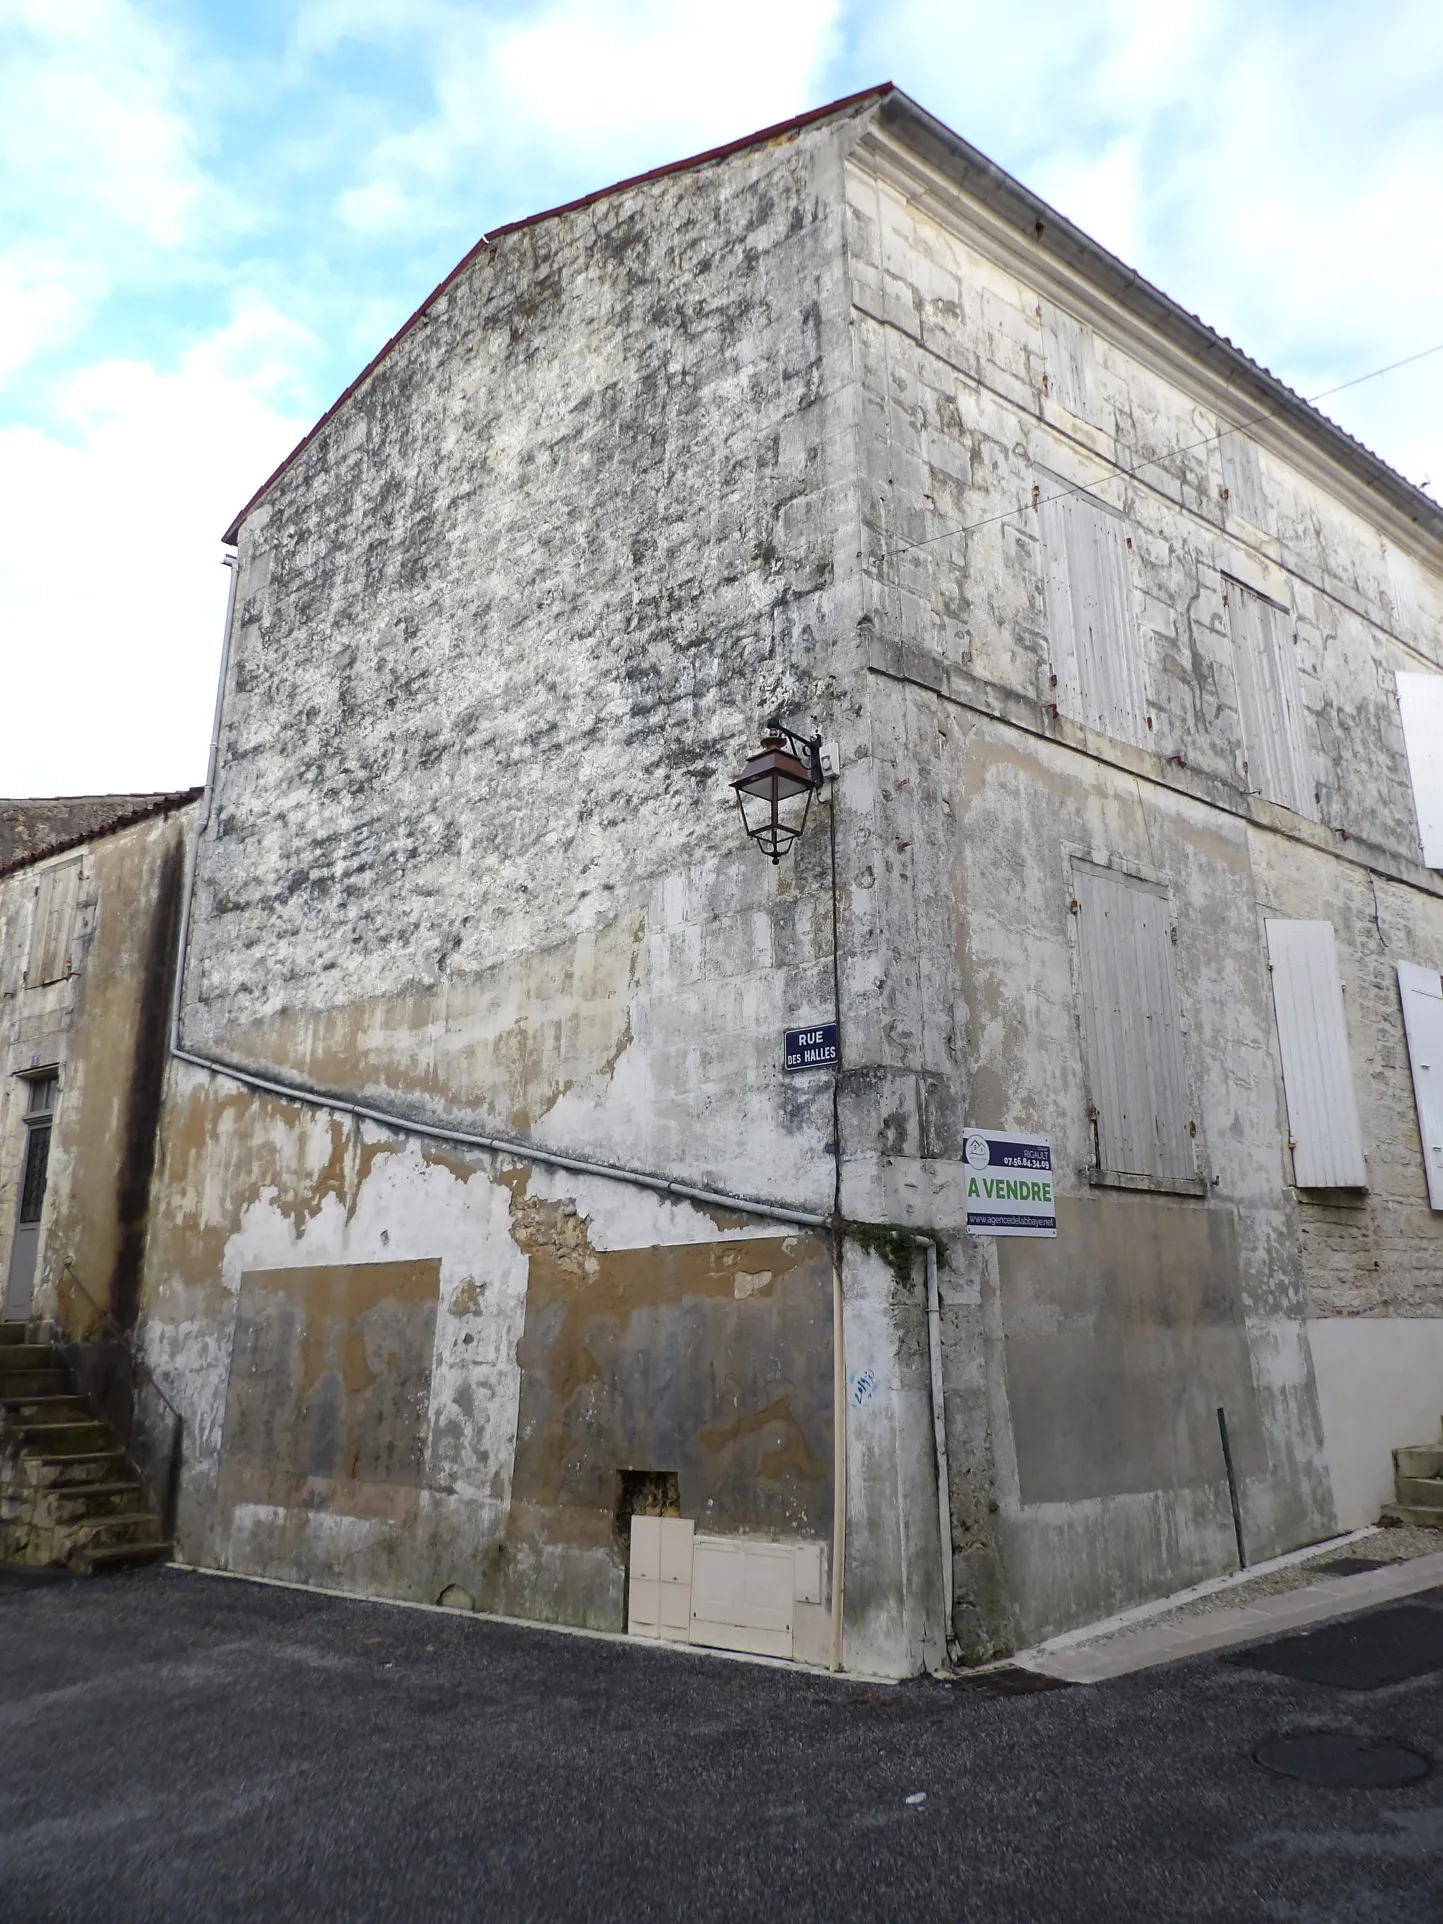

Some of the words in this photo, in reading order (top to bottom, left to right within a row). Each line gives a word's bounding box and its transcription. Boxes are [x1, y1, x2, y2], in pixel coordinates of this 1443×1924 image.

[799, 1031, 823, 1046] RUE
[787, 1054, 801, 1065] DES
[805, 1047, 836, 1062] HALLES
[1024, 1150, 1048, 1160] RIGAULT
[1004, 1157, 1050, 1169] 07.56.84.34.09
[968, 1177, 980, 1198] A
[983, 1178, 1052, 1202] VENDRE
[970, 1215, 1054, 1227] www.agencedelabbaye.net
